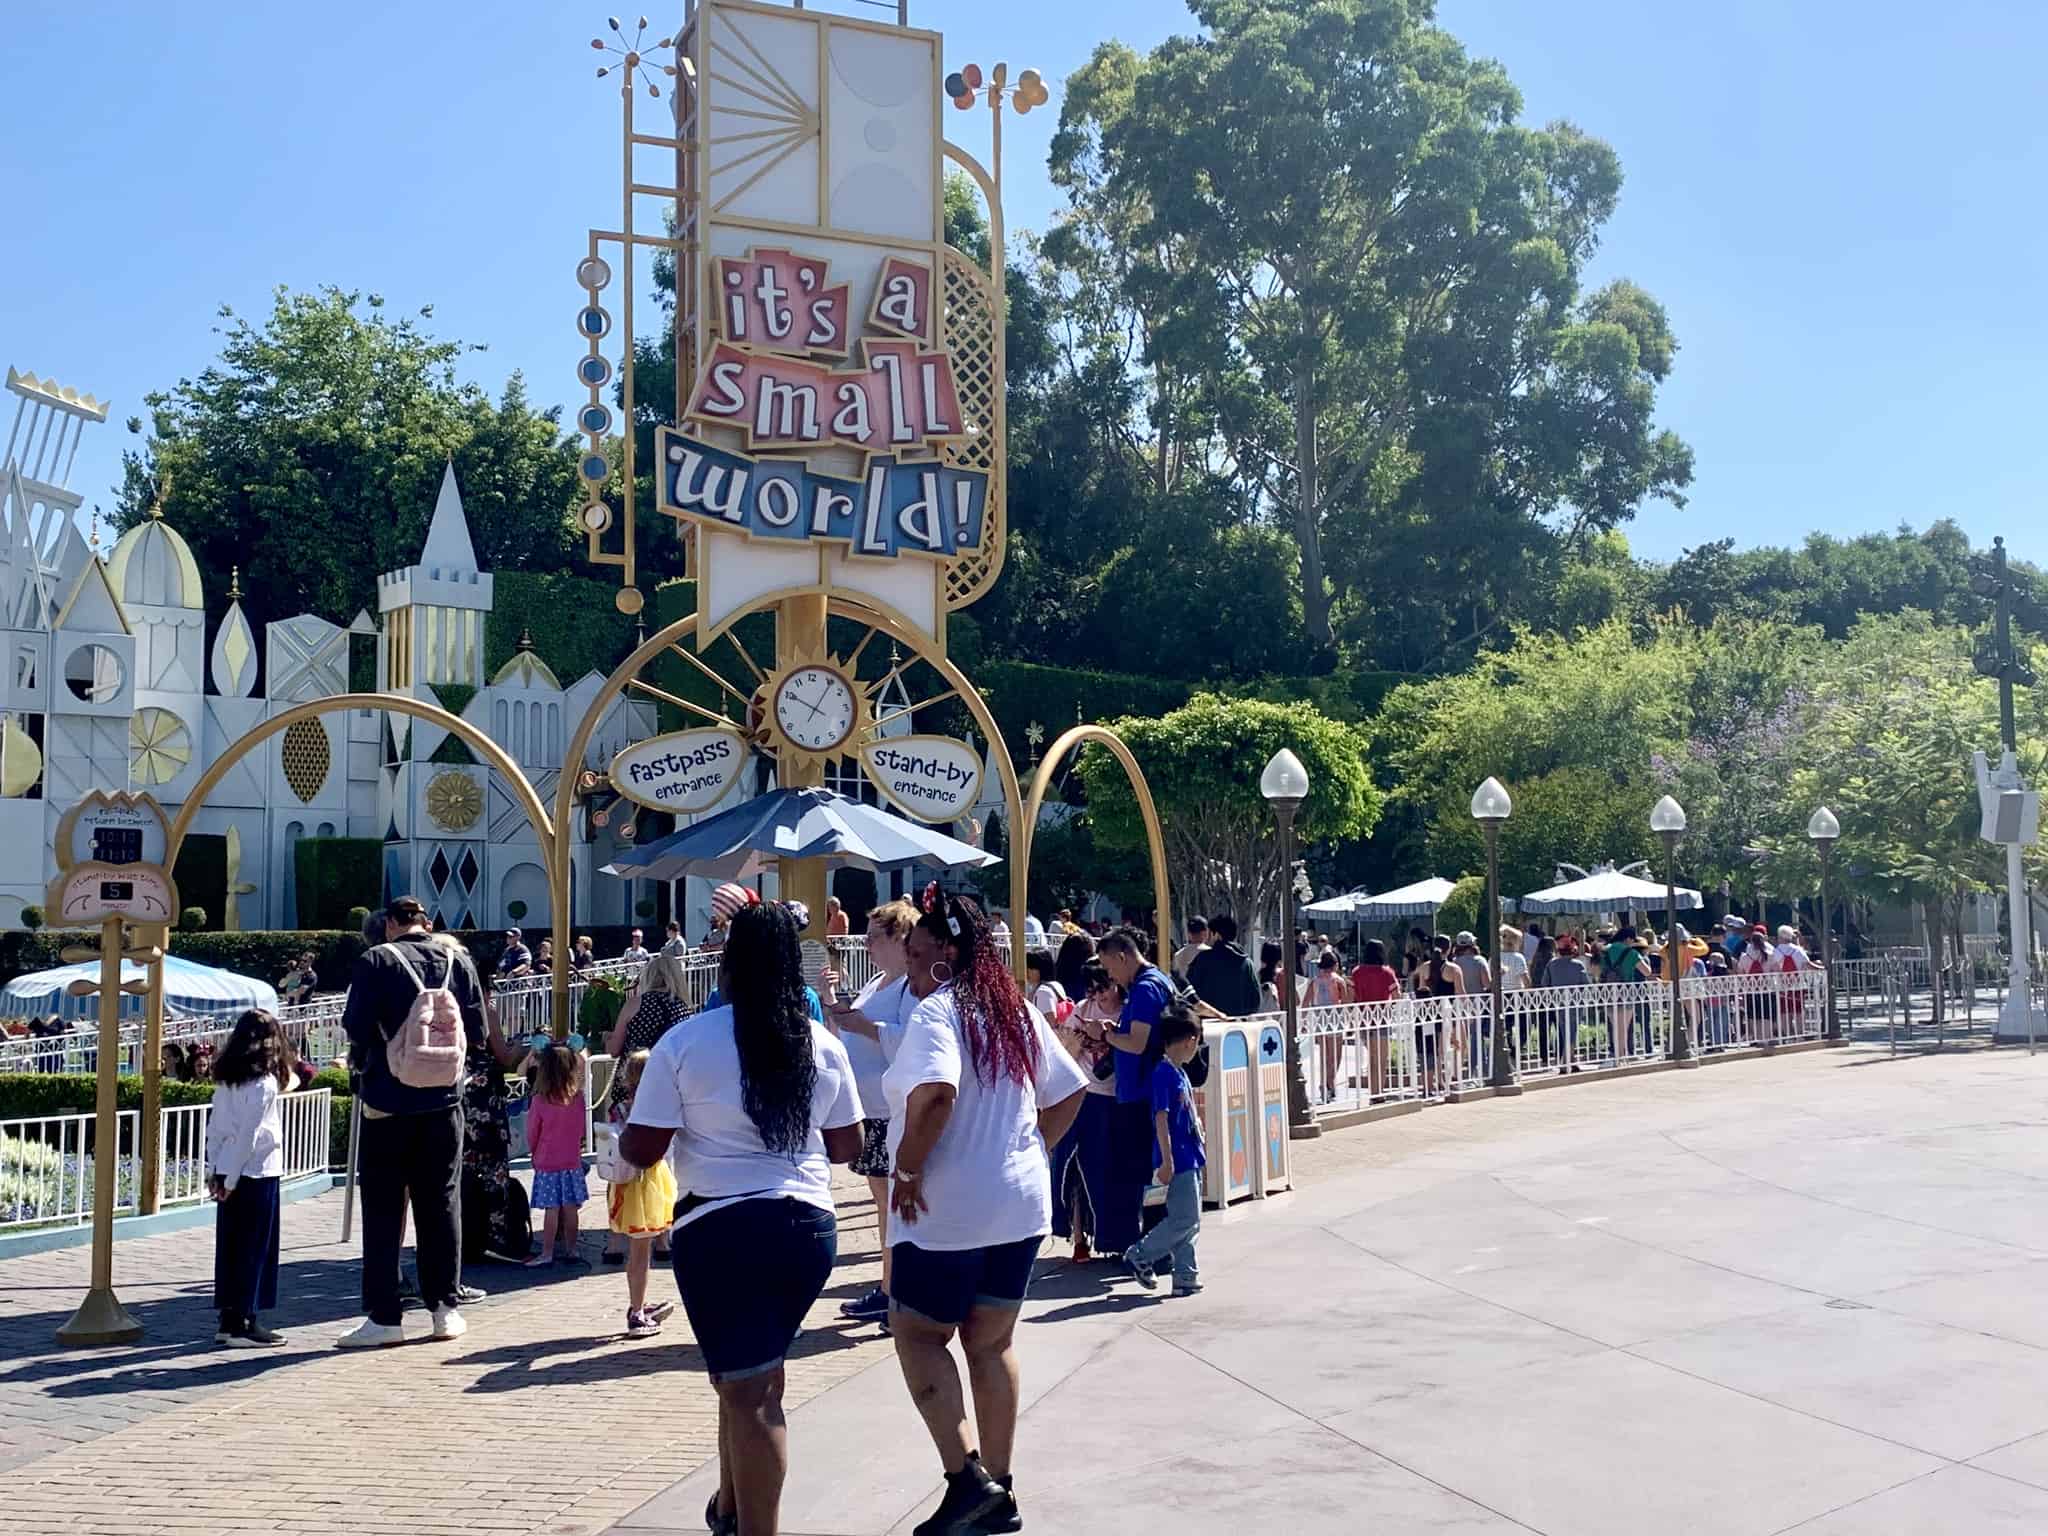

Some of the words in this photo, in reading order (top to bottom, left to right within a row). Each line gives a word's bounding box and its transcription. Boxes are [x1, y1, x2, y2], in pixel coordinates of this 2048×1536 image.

[726, 265, 837, 345] it's
[879, 274, 918, 331] a
[704, 353, 951, 441] small
[668, 444, 973, 552] world!
[795, 678, 803, 688] 11
[808, 673, 817, 682] 12
[837, 688, 843, 696] 2
[814, 736, 820, 744] 6
[828, 731, 836, 740] 5
[629, 740, 731, 784] fastpass
[874, 749, 975, 789] stand-by
[655, 772, 722, 800] entrance
[894, 780, 957, 804] entrance
[109, 884, 120, 897] 5
